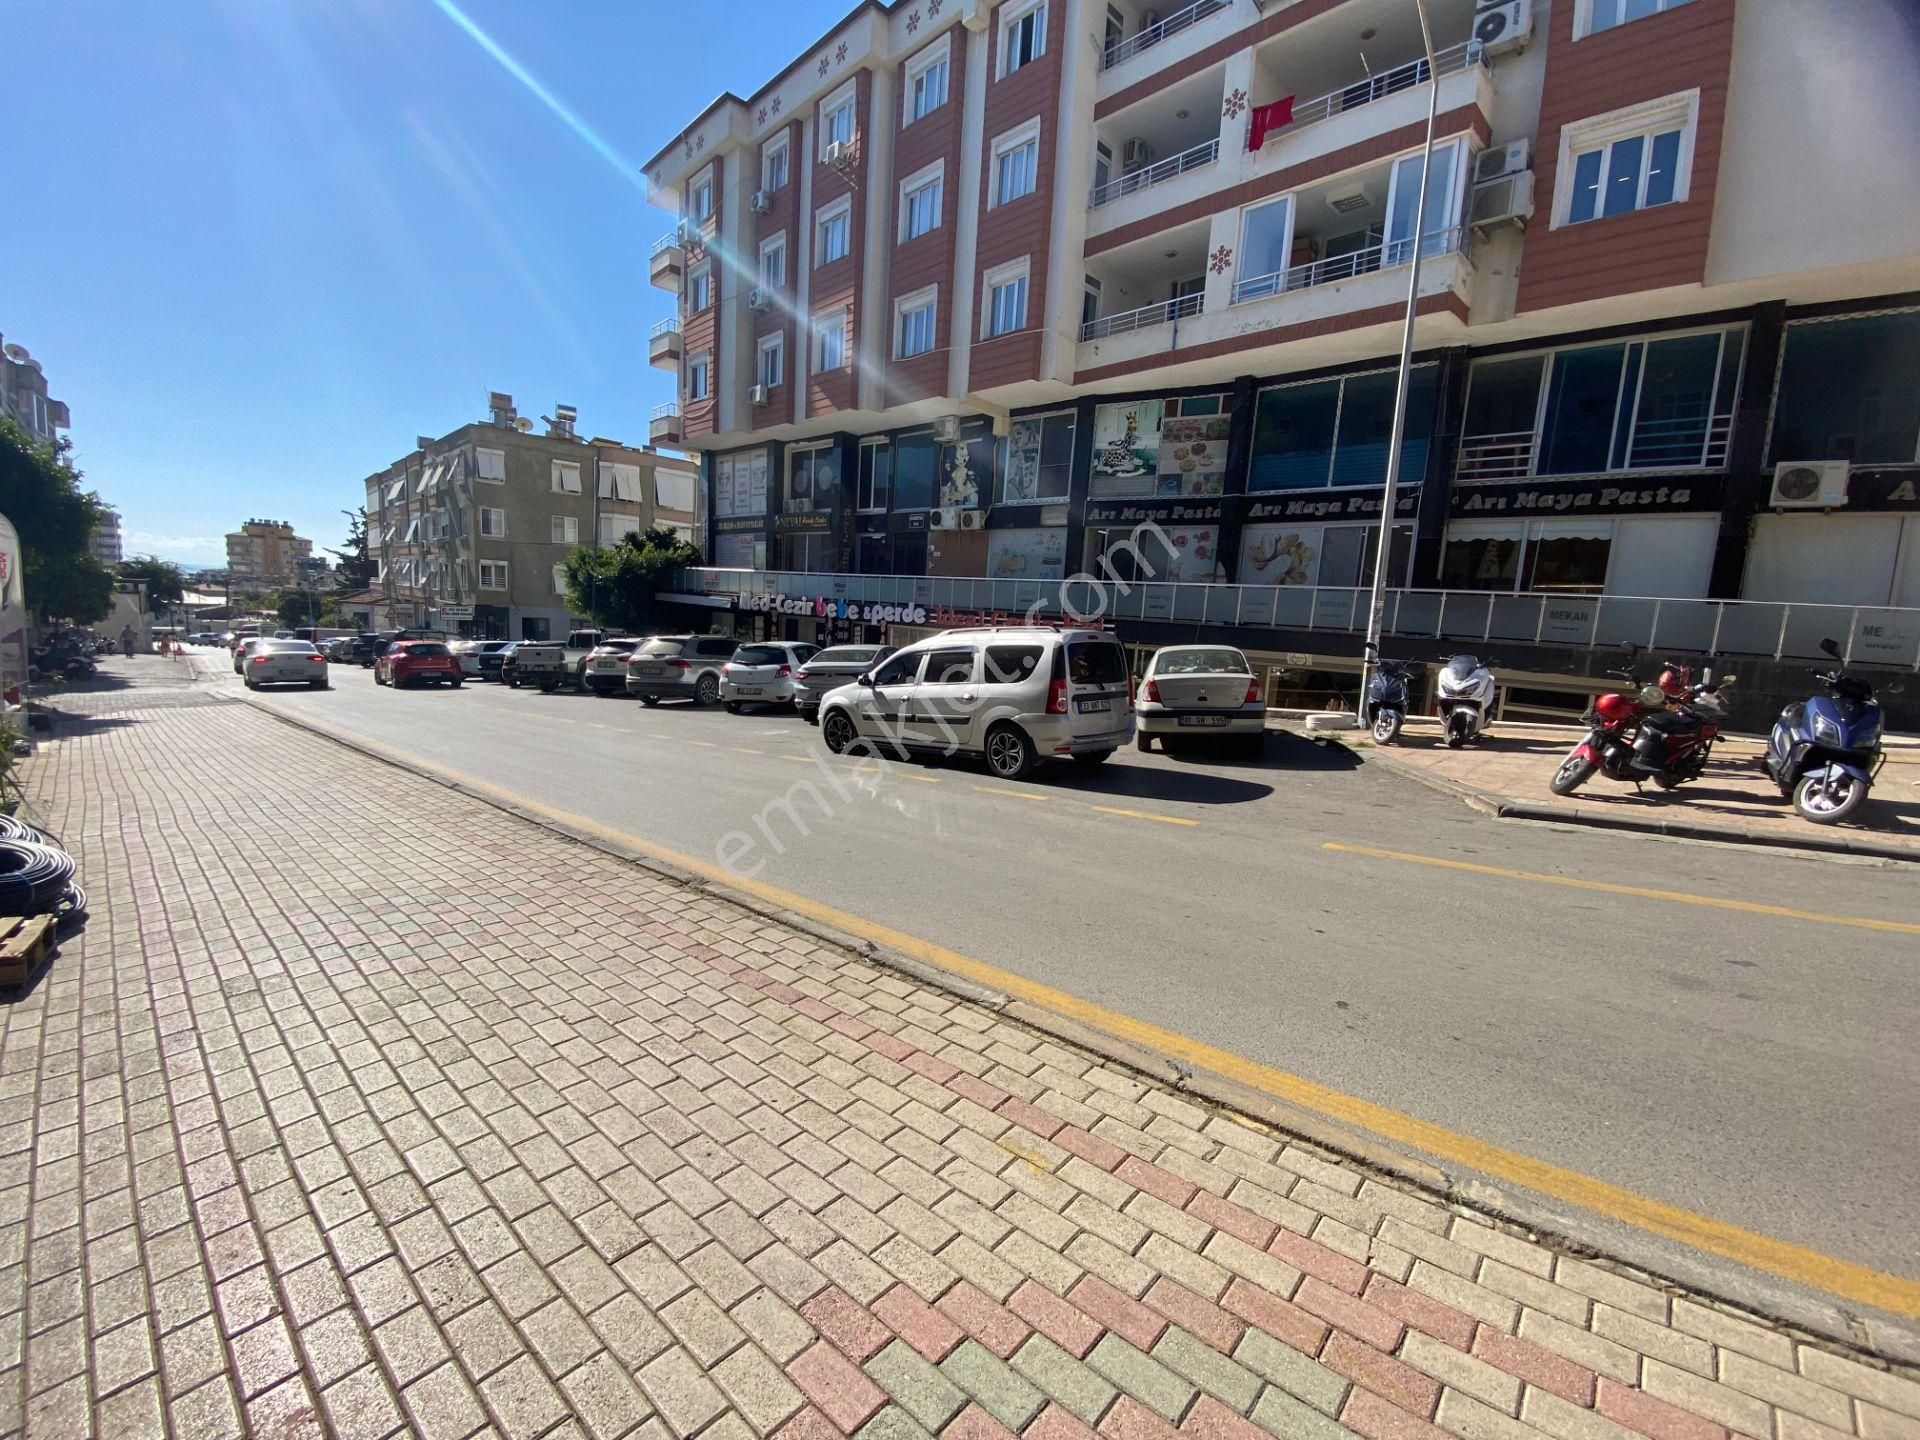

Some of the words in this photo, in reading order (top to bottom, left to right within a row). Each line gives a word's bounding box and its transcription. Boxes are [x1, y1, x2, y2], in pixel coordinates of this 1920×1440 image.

[1248, 503, 1282, 517] Arı
[1285, 501, 1342, 516] Maya
[1347, 498, 1414, 512] Pasa
[1463, 493, 1507, 510] Arı
[1513, 491, 1592, 510] Maya
[1598, 487, 1691, 505] Pasta
[1088, 508, 1117, 520] Arı
[1120, 507, 1168, 521] Maya
[816, 595, 859, 619] bebe
[871, 602, 926, 624] perde
[1549, 610, 1589, 622] MEKAN
